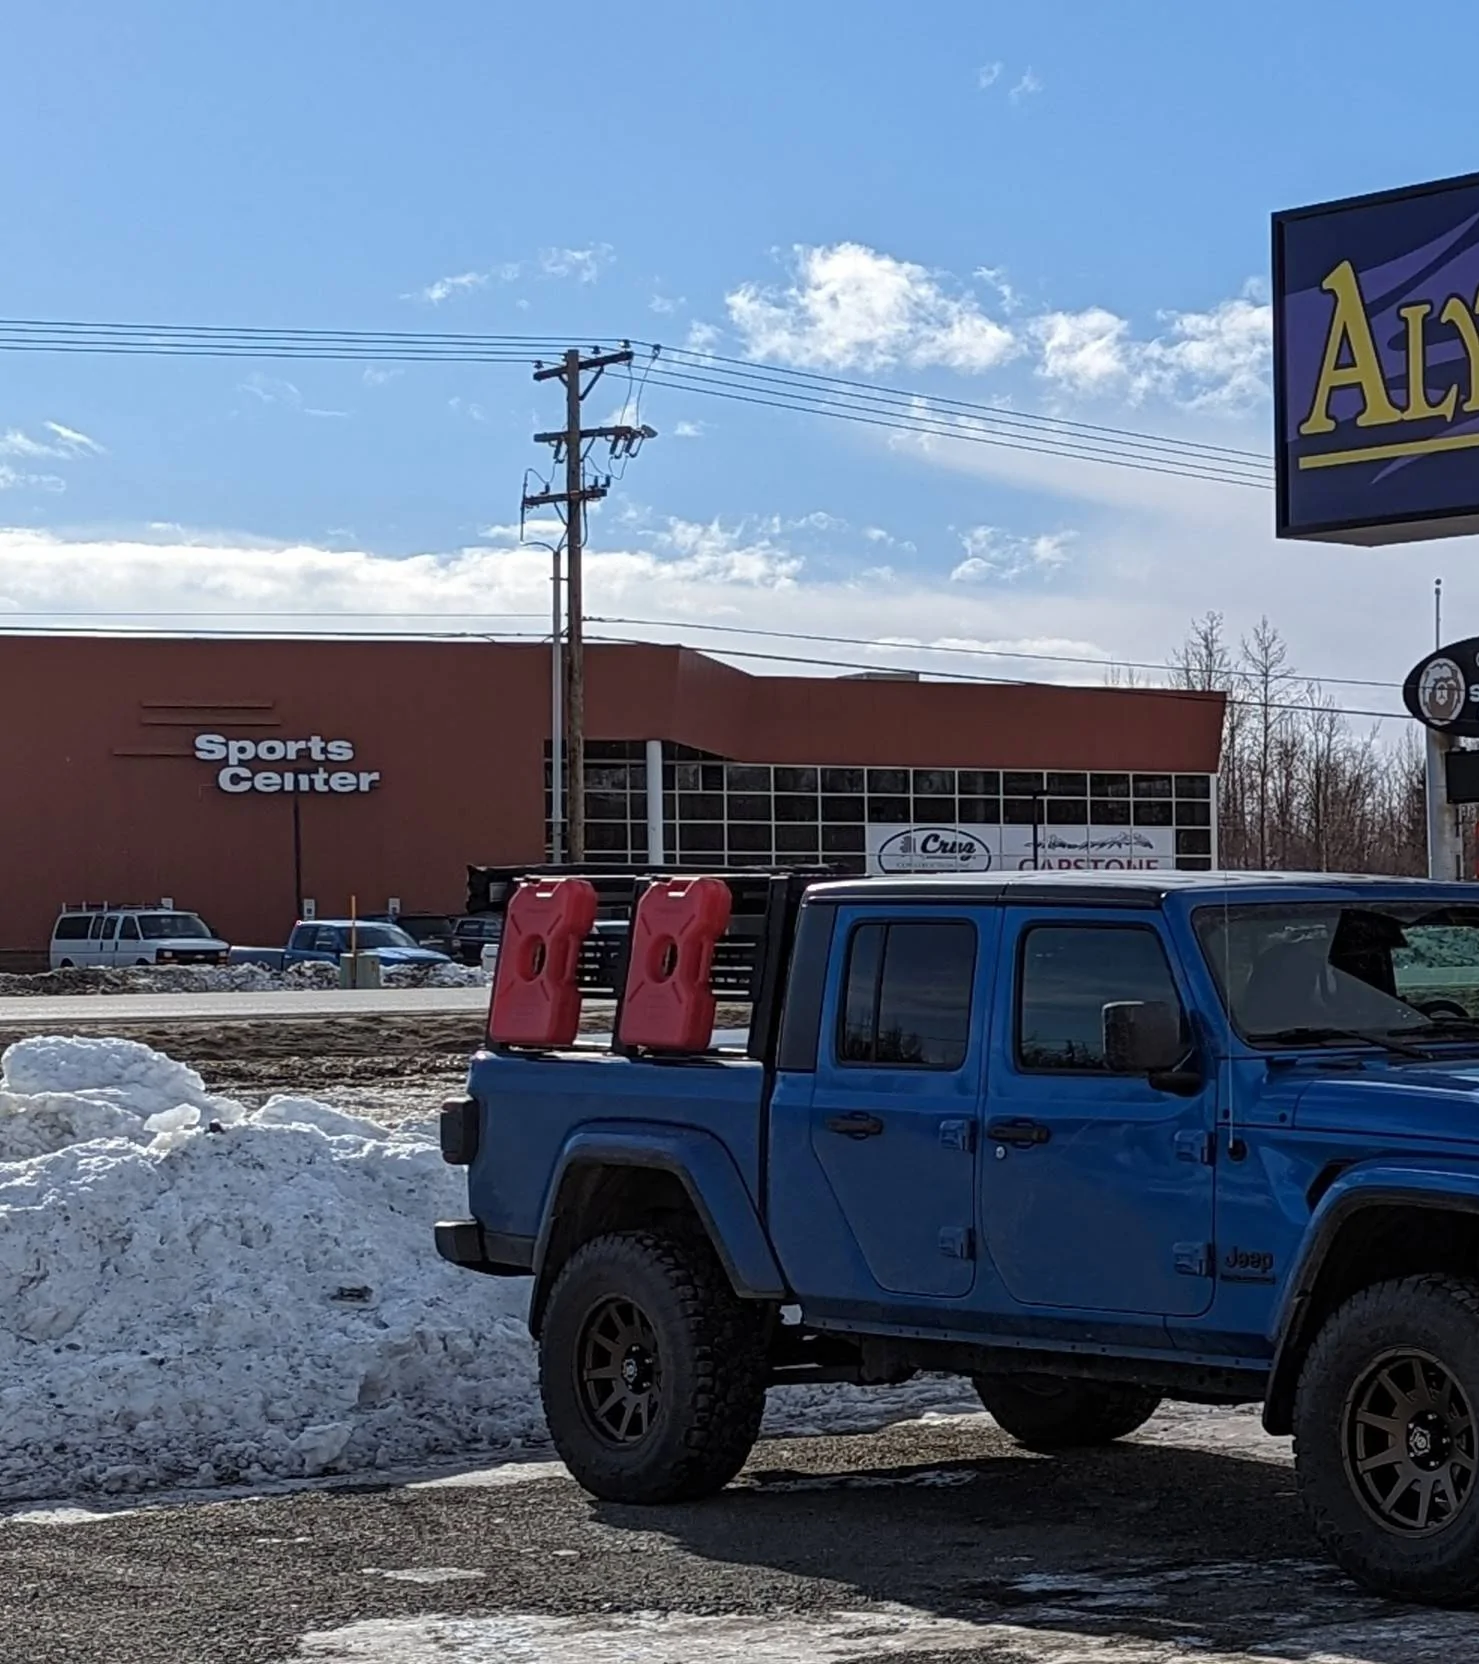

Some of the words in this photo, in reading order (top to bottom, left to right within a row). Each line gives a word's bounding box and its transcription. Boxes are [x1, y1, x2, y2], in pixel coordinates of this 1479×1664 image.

[194, 734, 354, 765] Sports
[218, 766, 380, 793] Center
[1225, 1246, 1274, 1274] Jeep
